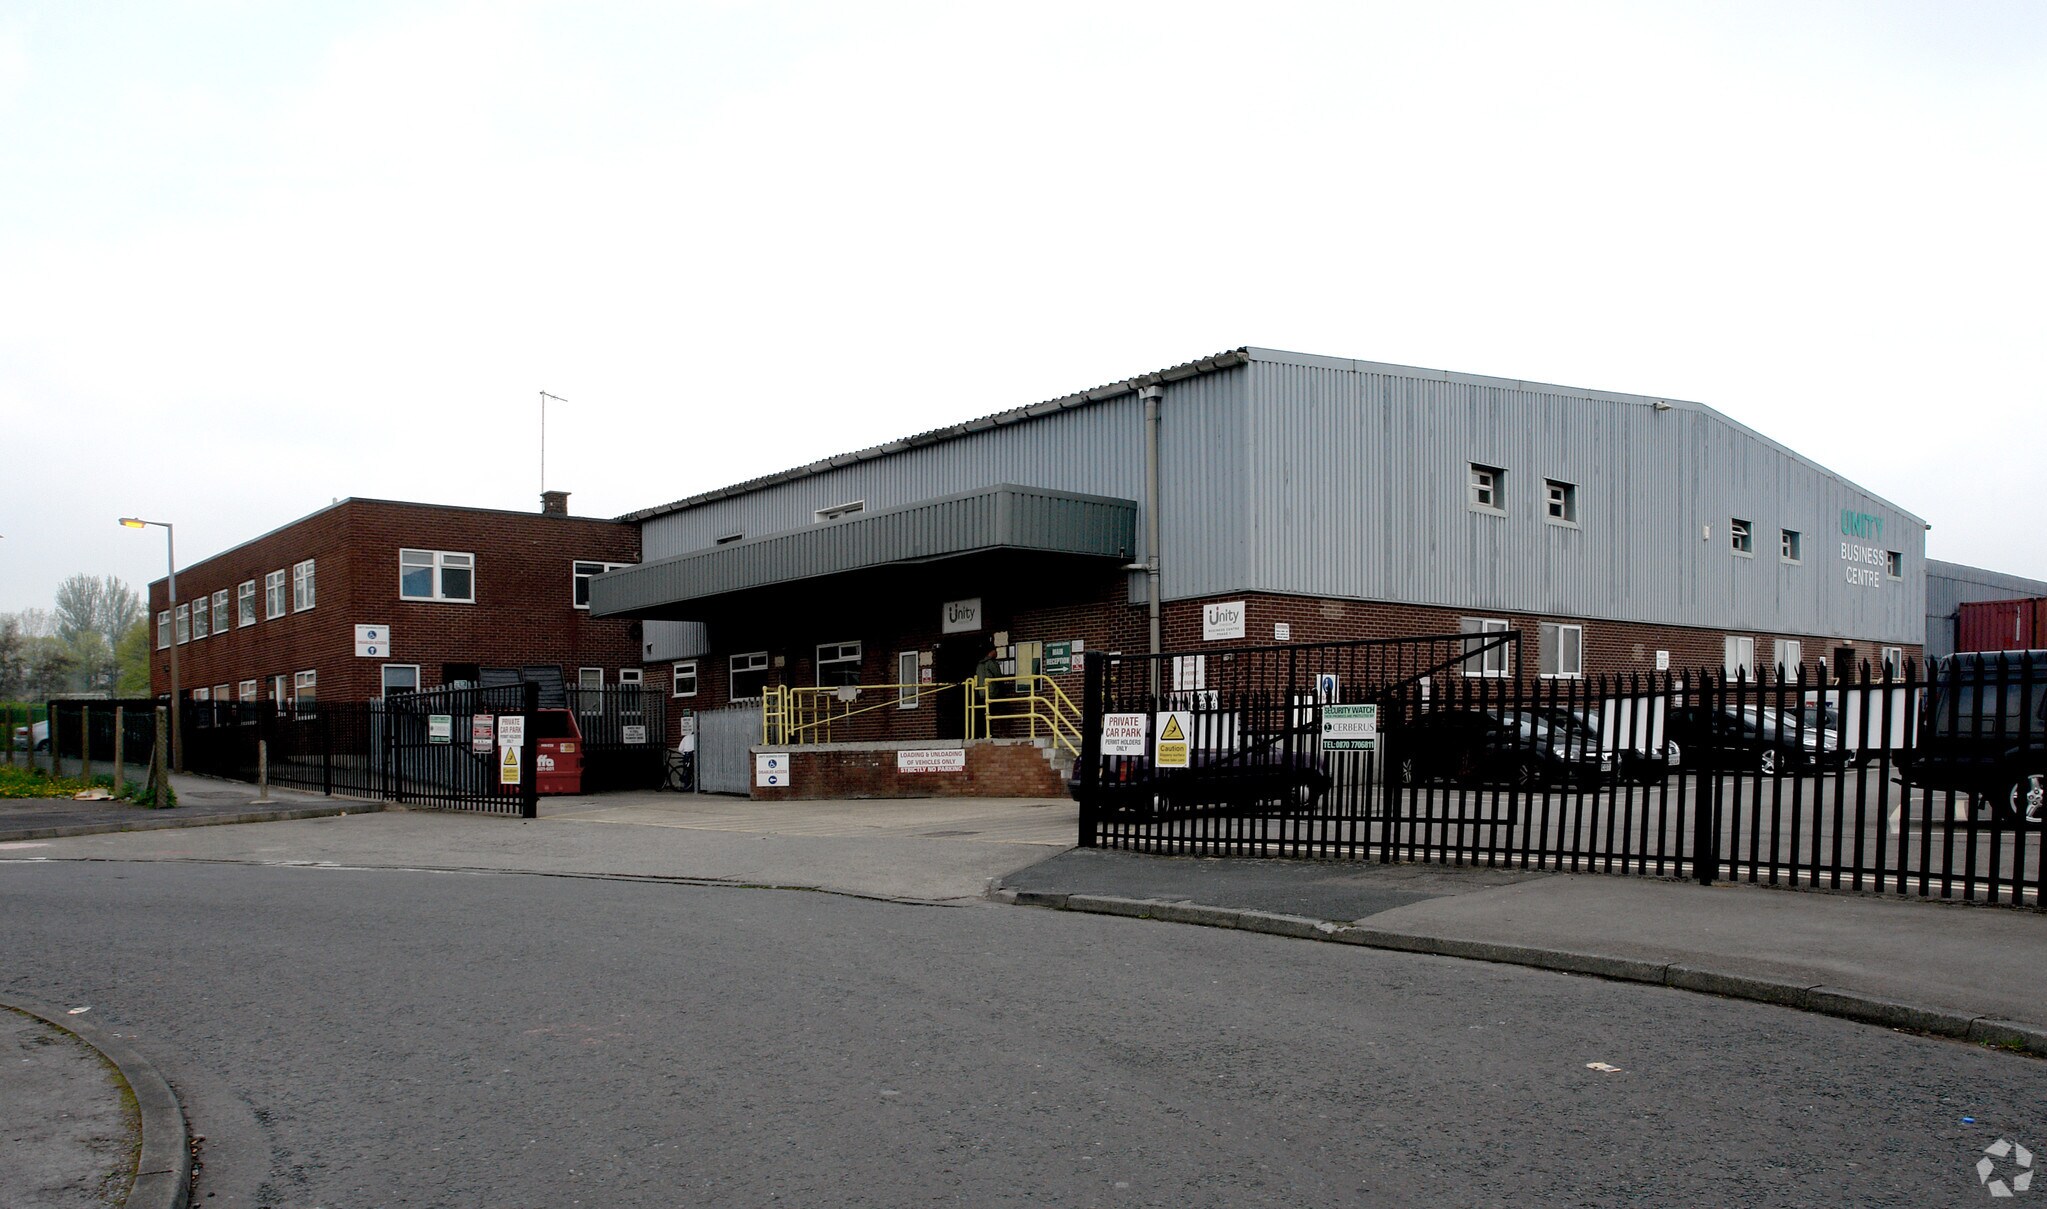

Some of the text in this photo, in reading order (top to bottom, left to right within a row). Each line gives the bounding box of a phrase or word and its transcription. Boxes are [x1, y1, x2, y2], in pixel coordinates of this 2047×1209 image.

[1841, 508, 1884, 540] UNITY
[1841, 542, 1884, 566] BUSINESS
[1846, 566, 1880, 588] CENTRE
[949, 603, 976, 623] Unity
[1209, 606, 1239, 625] Unity
[1324, 706, 1375, 714] SECURITY WATCH
[1109, 717, 1139, 726] PRIVATE
[1333, 722, 1374, 731] CERBERUS
[1105, 728, 1142, 737] CAR PARK
